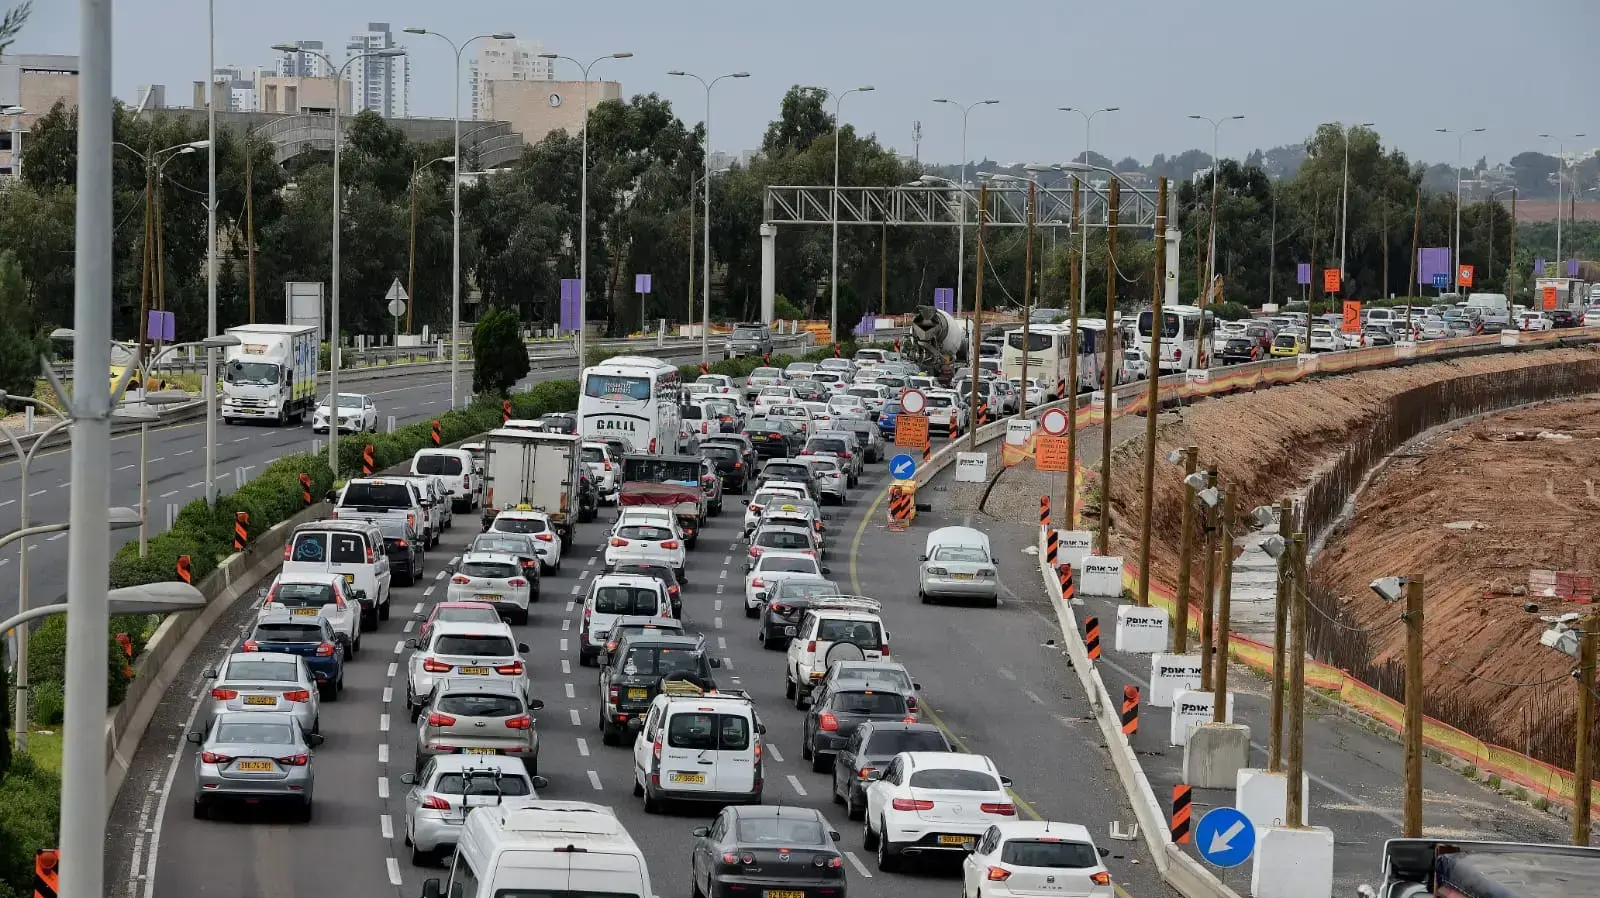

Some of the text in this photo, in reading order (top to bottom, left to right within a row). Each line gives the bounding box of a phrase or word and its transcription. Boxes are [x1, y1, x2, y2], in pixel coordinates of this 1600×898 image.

[597, 420, 636, 431] GALIL
[1086, 565, 1106, 573] אופק
[1160, 666, 1185, 674] אופק
[1181, 703, 1208, 711] אופק
